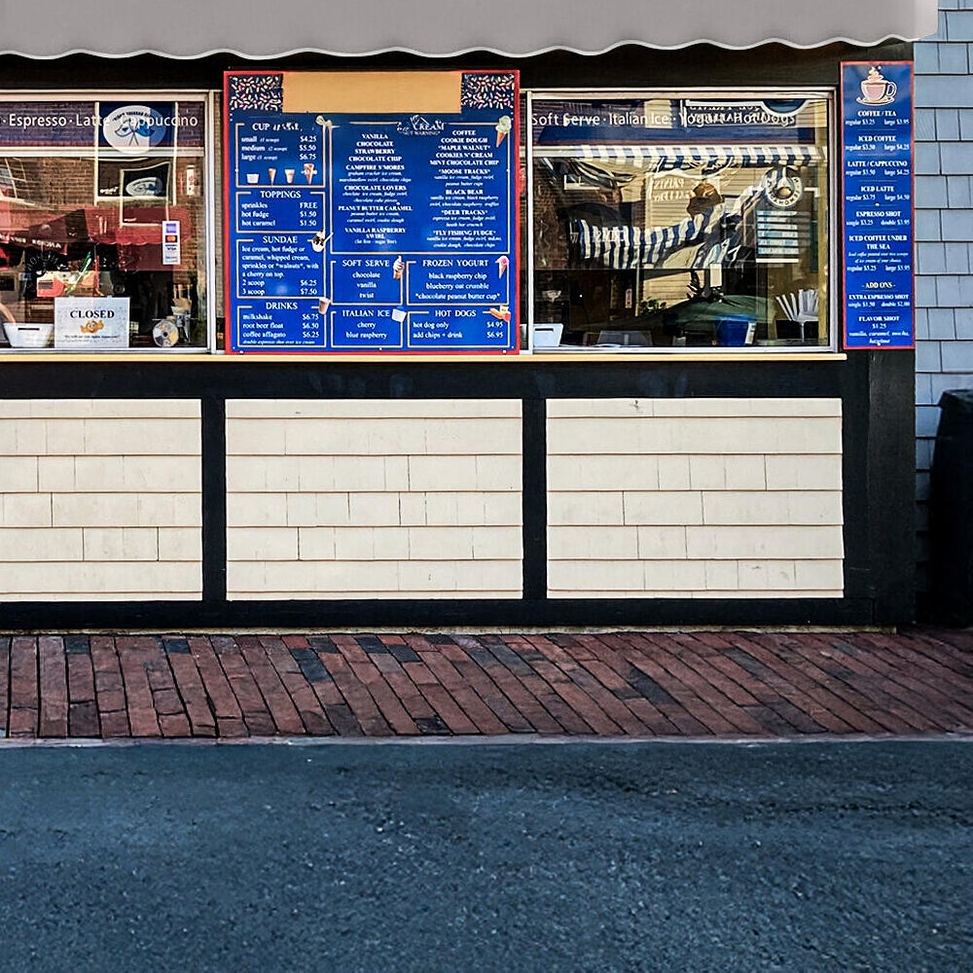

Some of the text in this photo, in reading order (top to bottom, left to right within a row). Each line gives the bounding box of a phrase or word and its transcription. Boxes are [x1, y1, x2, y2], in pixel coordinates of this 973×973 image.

[9, 113, 67, 129] Espresso
[532, 112, 559, 125] Soft
[563, 112, 600, 125] Serve
[609, 112, 647, 125] Italian
[651, 112, 667, 125] Ice
[252, 123, 270, 131] CUP
[299, 153, 316, 161] $6.75
[446, 272, 473, 280] raspberry
[474, 272, 487, 280] chip
[70, 310, 115, 318] CLOSED
